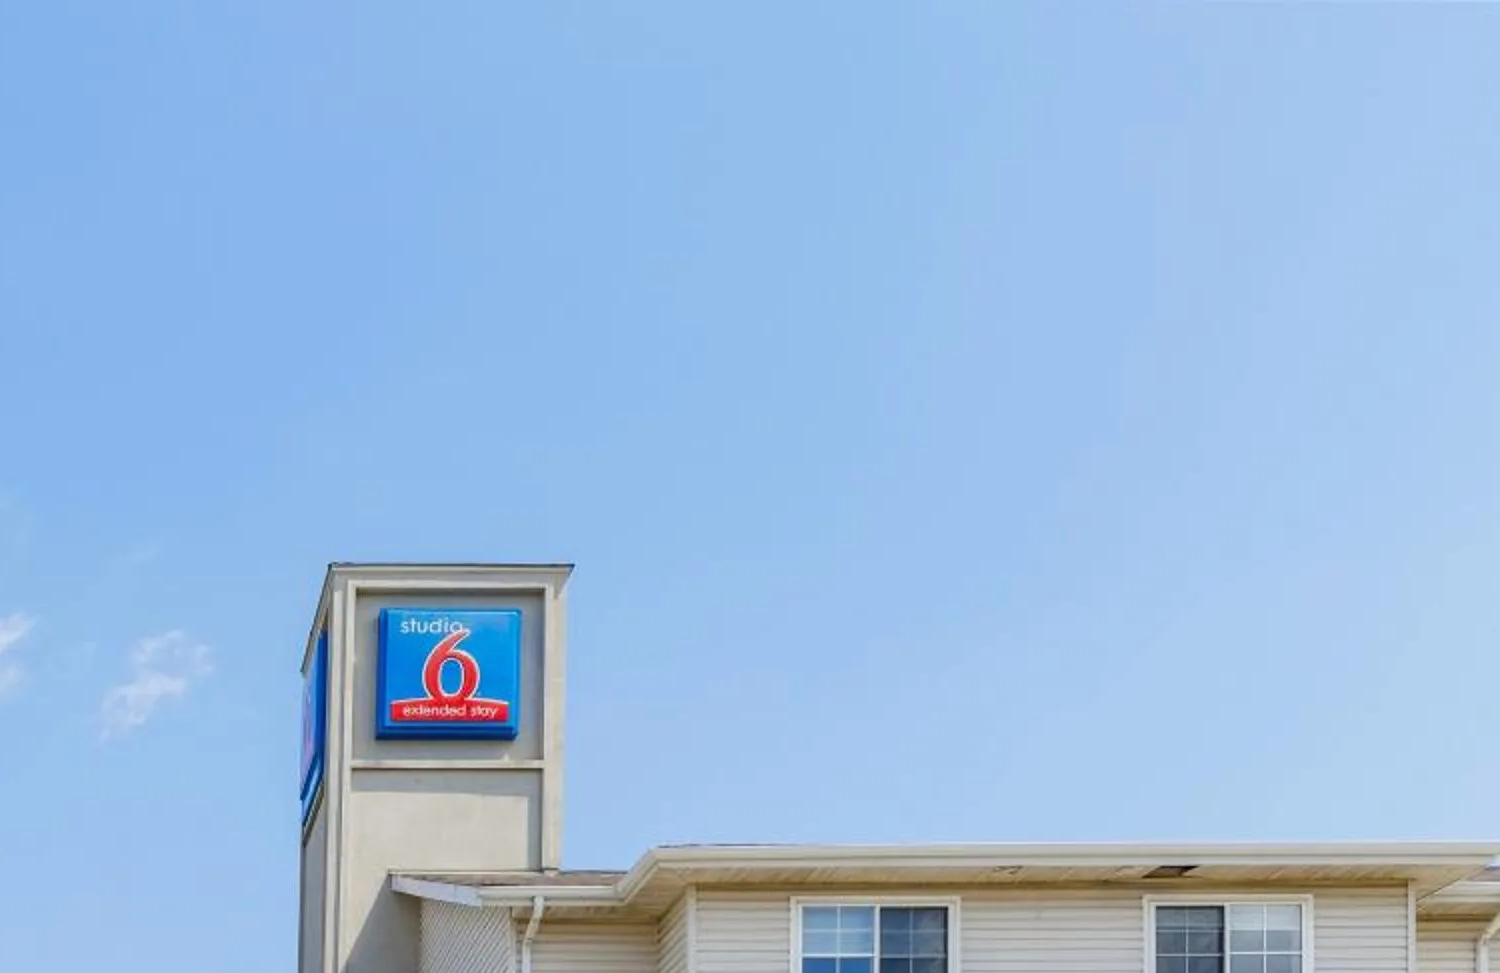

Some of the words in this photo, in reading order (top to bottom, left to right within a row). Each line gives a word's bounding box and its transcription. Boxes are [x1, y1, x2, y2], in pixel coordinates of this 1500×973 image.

[401, 617, 463, 633] studio
[422, 628, 480, 700] 6
[403, 704, 467, 717] extended
[471, 705, 499, 718] stay
